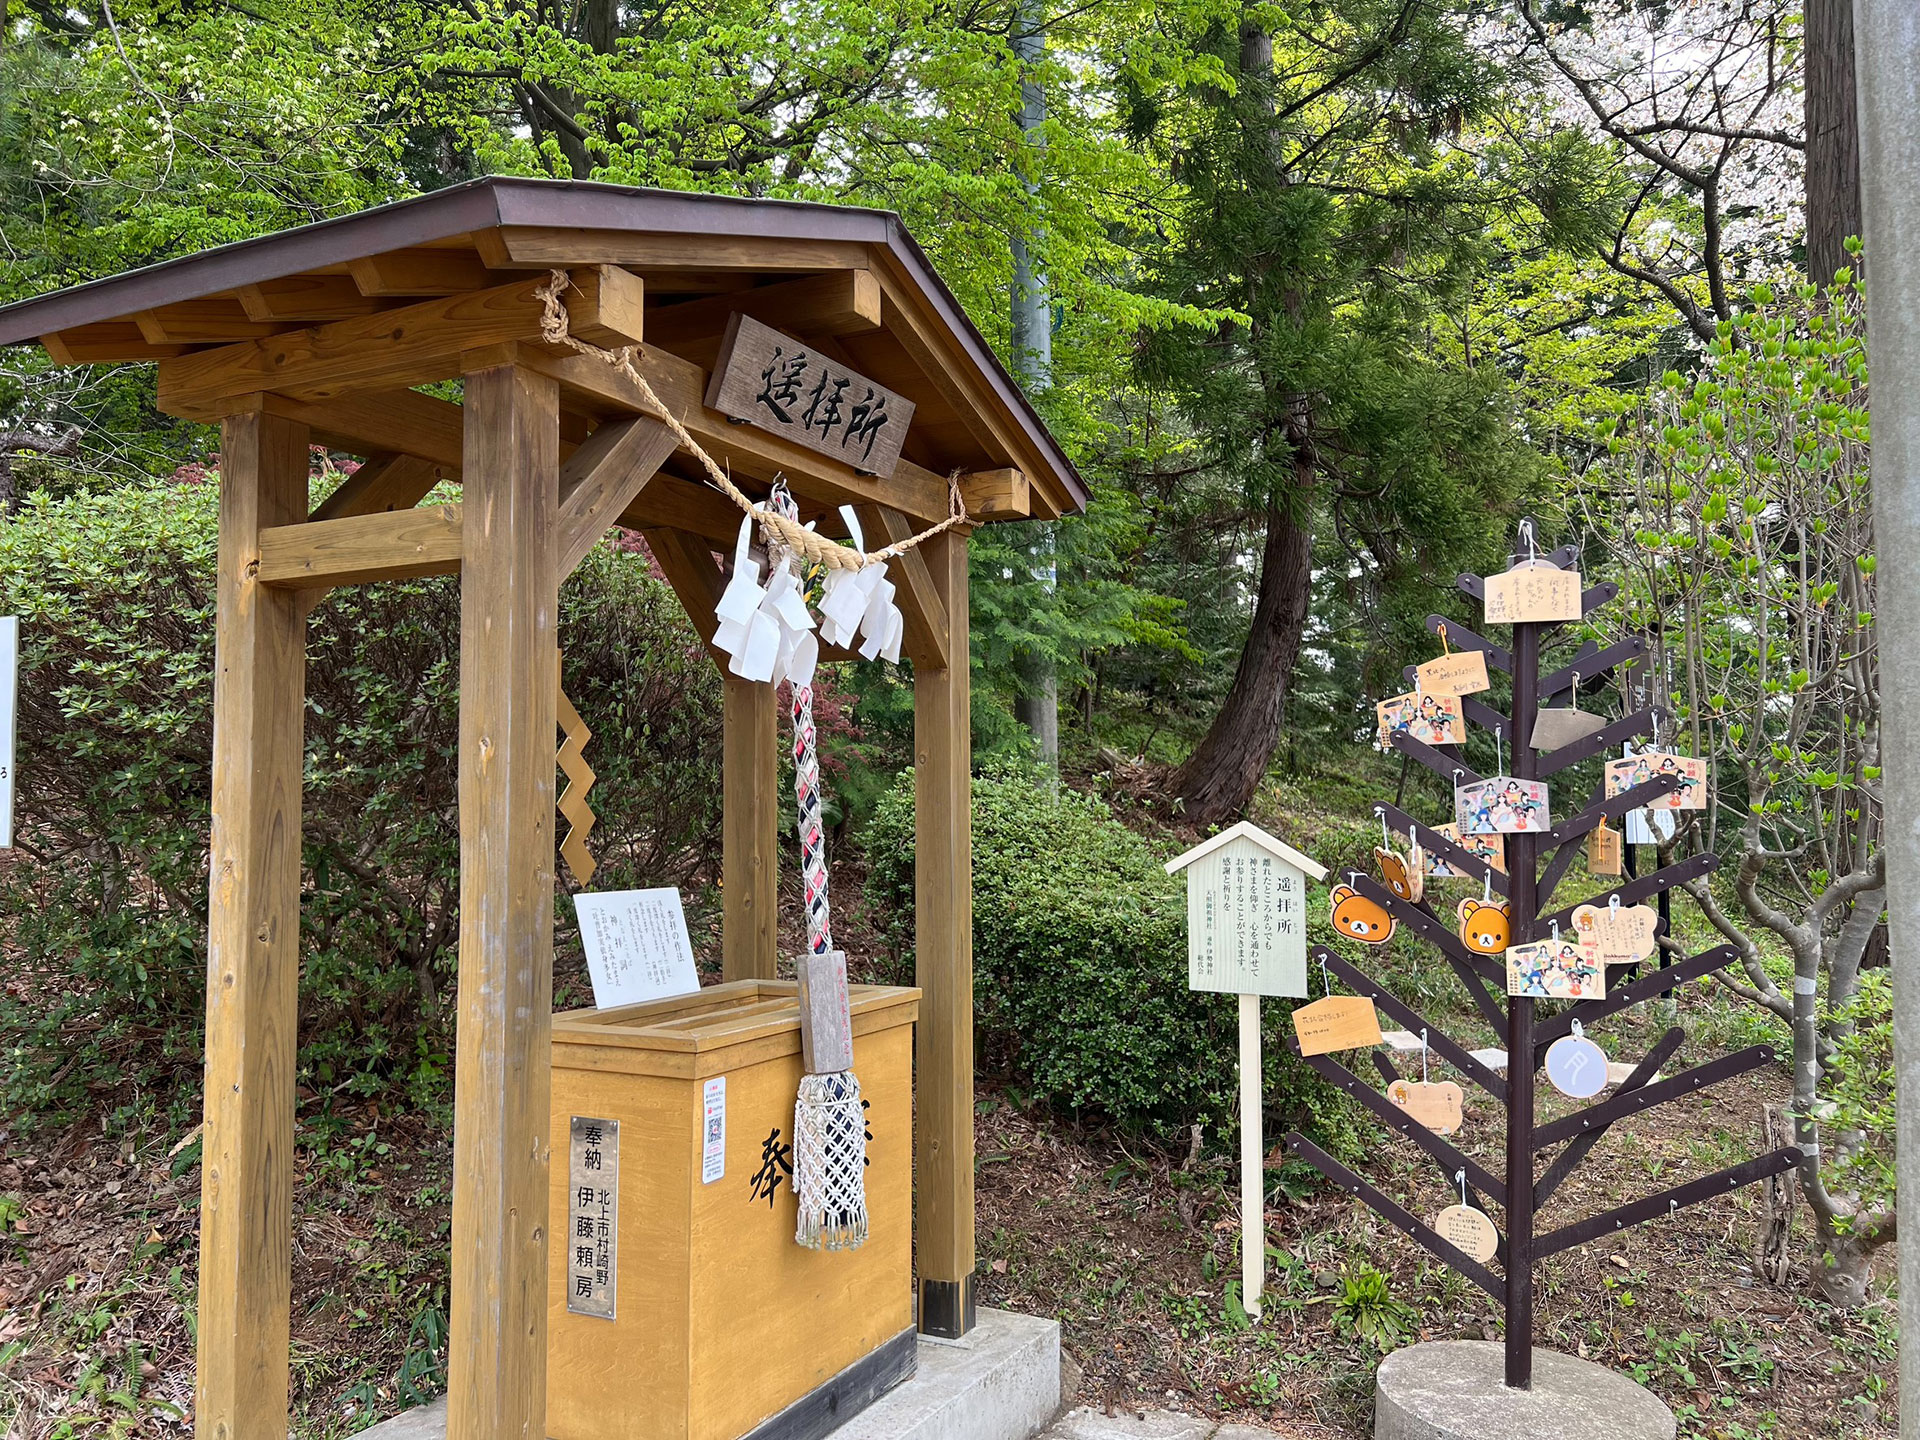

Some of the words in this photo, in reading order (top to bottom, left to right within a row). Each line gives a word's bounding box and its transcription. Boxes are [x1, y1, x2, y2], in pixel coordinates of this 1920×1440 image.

[1687, 761, 1697, 777] 祈願
[1222, 857, 1231, 912] 感謝と祈りを
[1249, 858, 1259, 913] 神さまを仰ぎ
[1262, 858, 1273, 950] 離れたところからでも
[1276, 876, 1292, 935] 遥拝所
[668, 910, 684, 962] 参拝の作法
[1235, 858, 1247, 972] お参りすることができます。
[1250, 921, 1260, 977] 心を通わせて
[585, 1125, 602, 1171] 奉納
[576, 1186, 594, 1299] 伊藤頼房
[596, 1189, 610, 1286] 北上市村崎野
